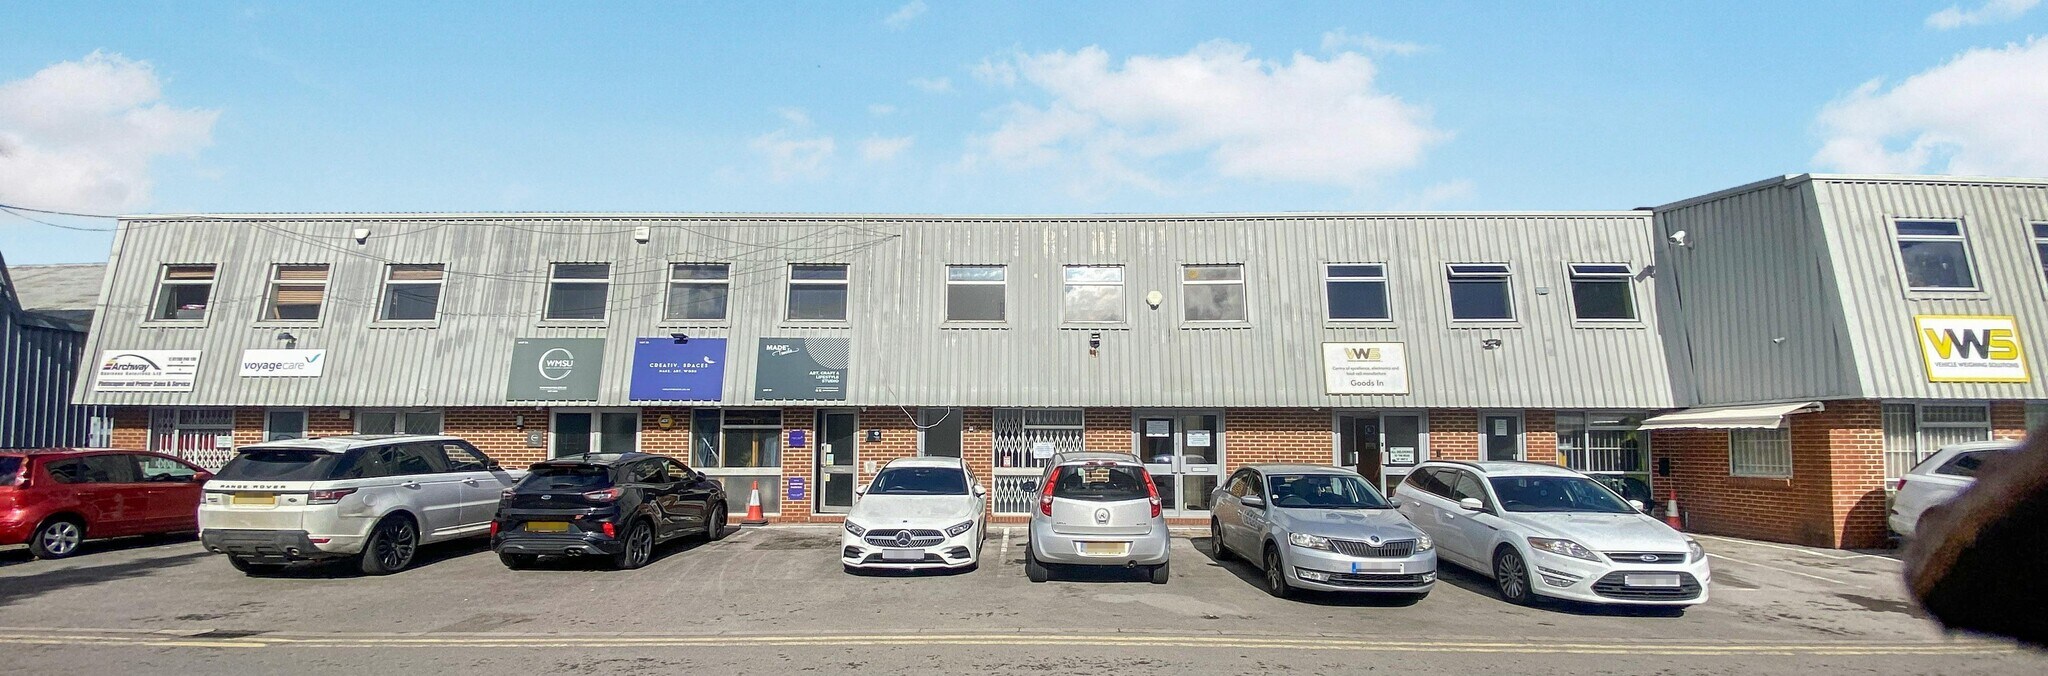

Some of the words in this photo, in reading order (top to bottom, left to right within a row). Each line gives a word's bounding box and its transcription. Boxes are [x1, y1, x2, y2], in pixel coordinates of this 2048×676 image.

[1923, 328, 2019, 360] VWS
[1344, 348, 1381, 359] VWS
[111, 362, 150, 372] Archway
[244, 362, 304, 371] voyagecare
